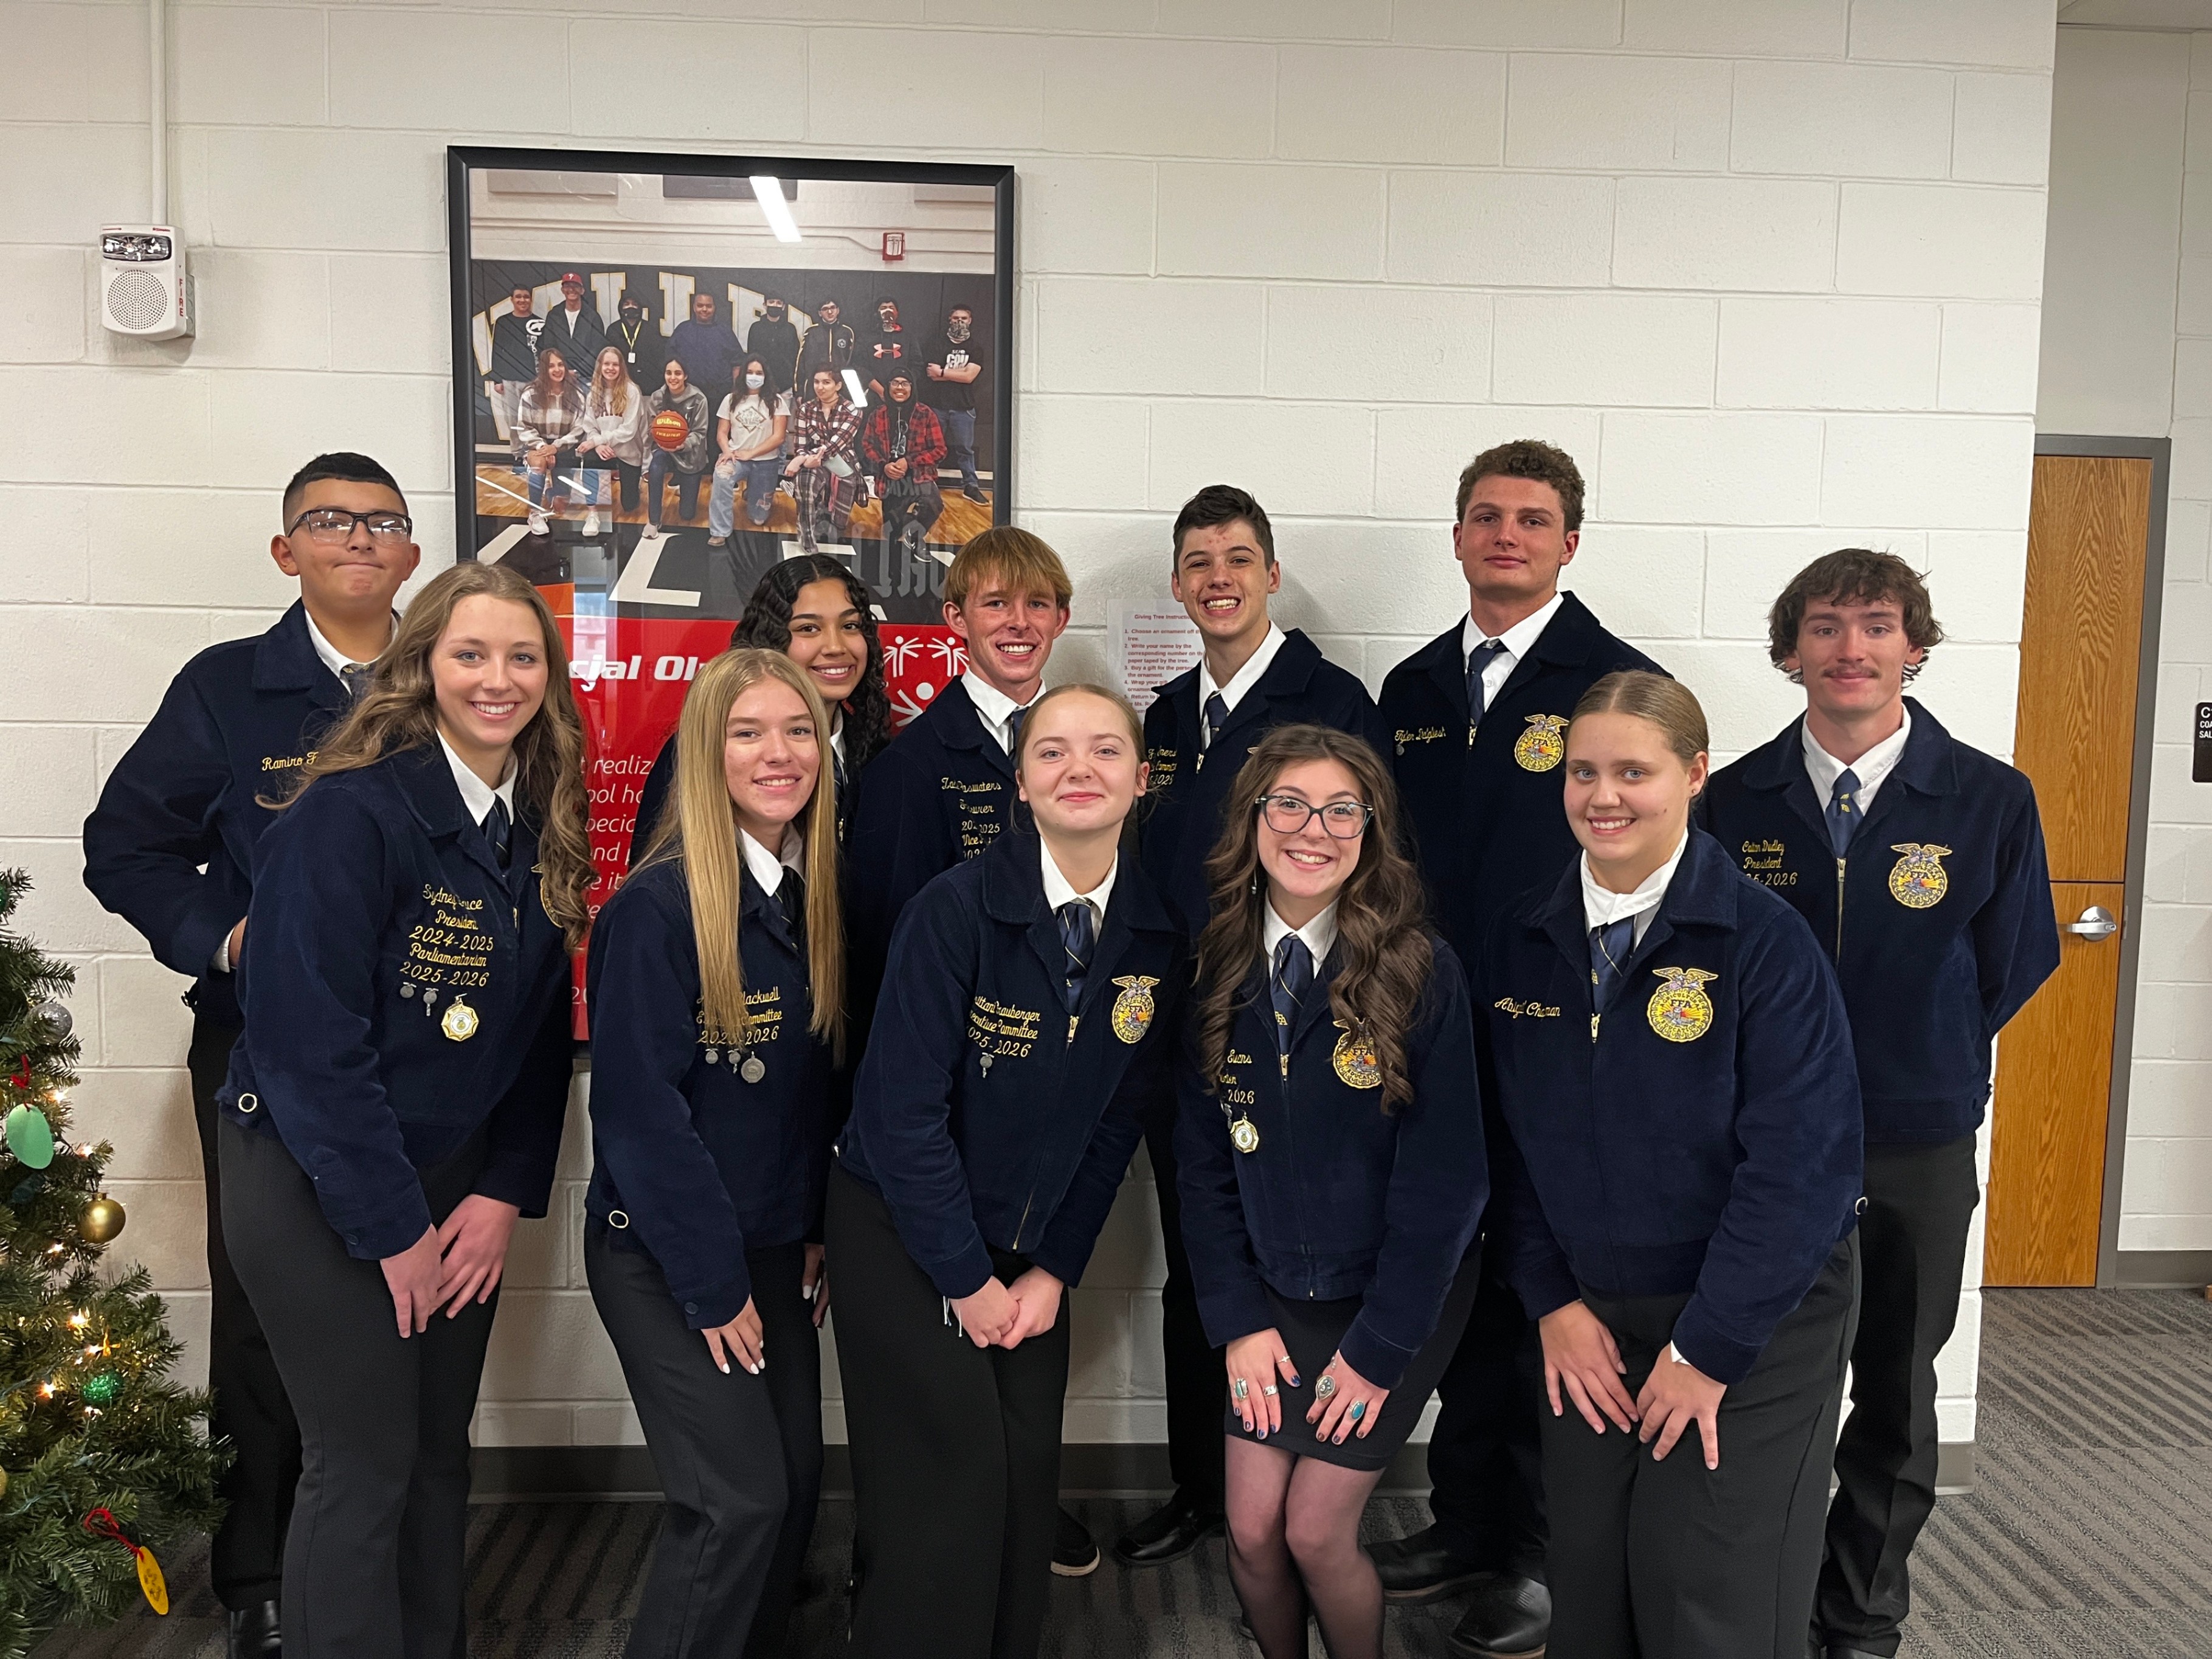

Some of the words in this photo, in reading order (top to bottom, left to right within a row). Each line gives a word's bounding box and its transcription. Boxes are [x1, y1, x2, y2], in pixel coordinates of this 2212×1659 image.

[261, 756, 304, 771] Ramiro
[1743, 856, 1782, 869] President
[408, 925, 494, 951] 2024-2025
[409, 942, 487, 967] Parliamentarian
[399, 961, 490, 987] 2025-2026
[1670, 999, 1692, 1008] FFA
